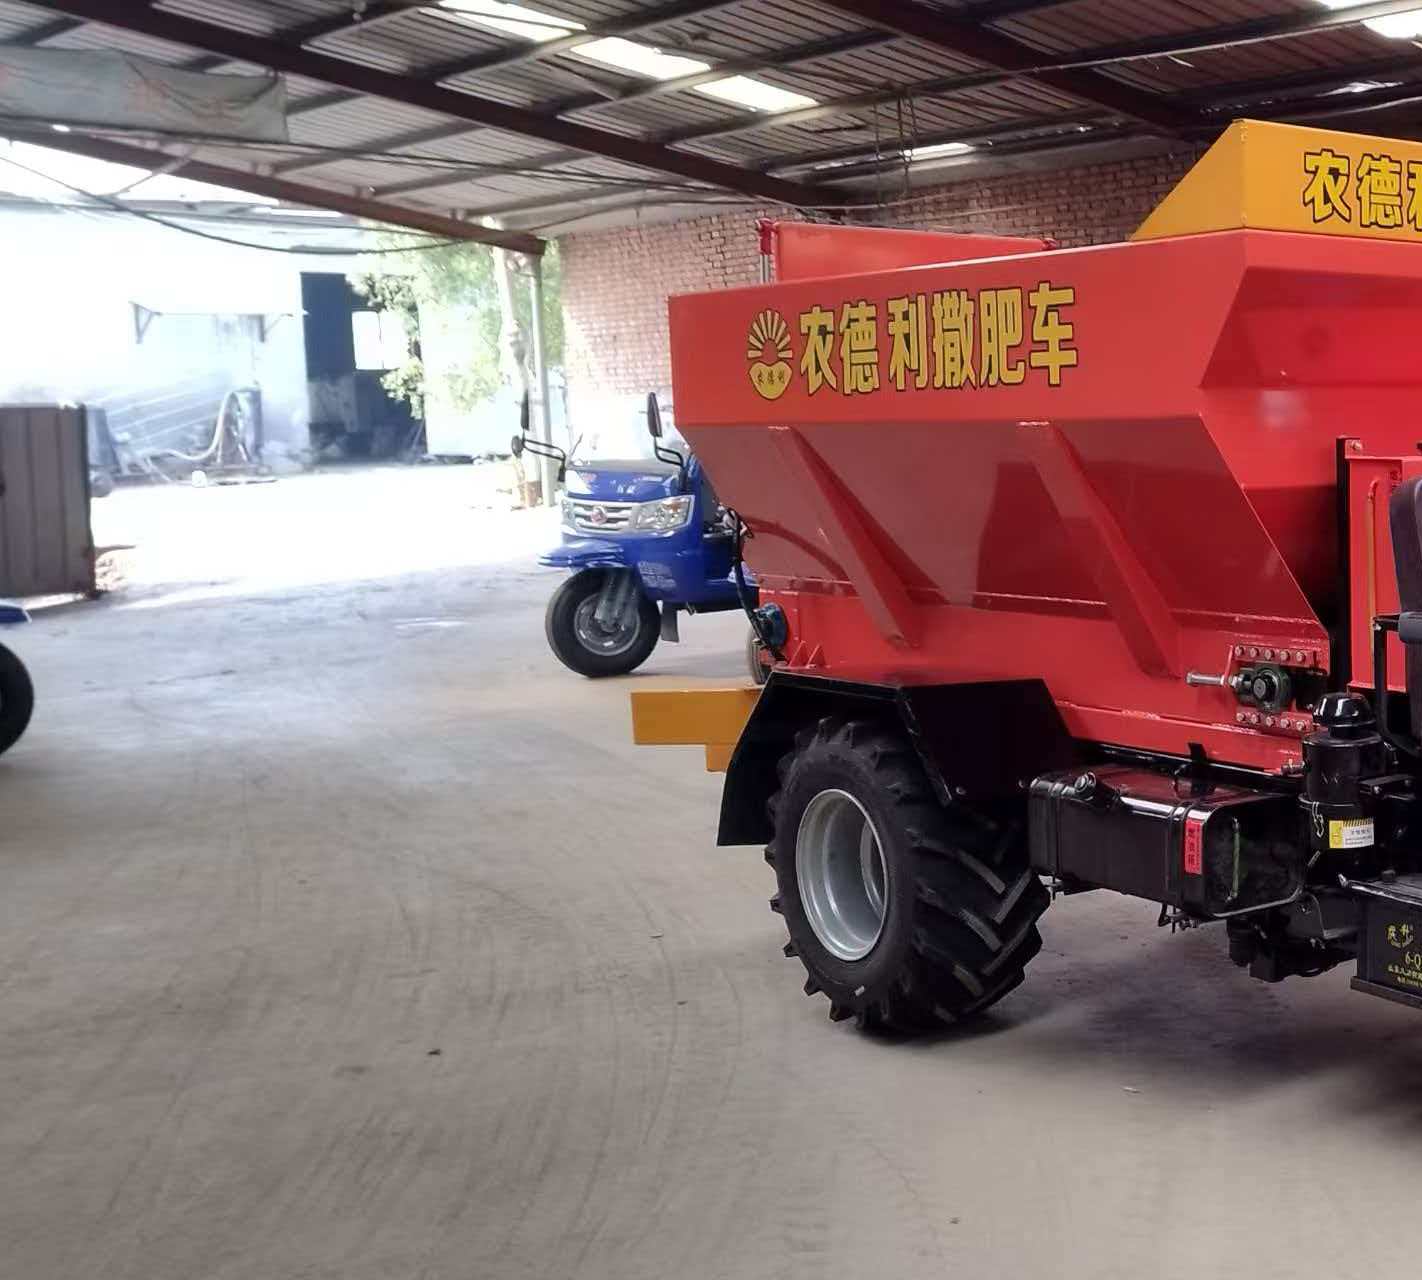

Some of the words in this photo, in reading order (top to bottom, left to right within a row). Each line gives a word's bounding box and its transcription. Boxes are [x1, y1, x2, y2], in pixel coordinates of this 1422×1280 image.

[800, 280, 1077, 395] 农德利撒肥车
